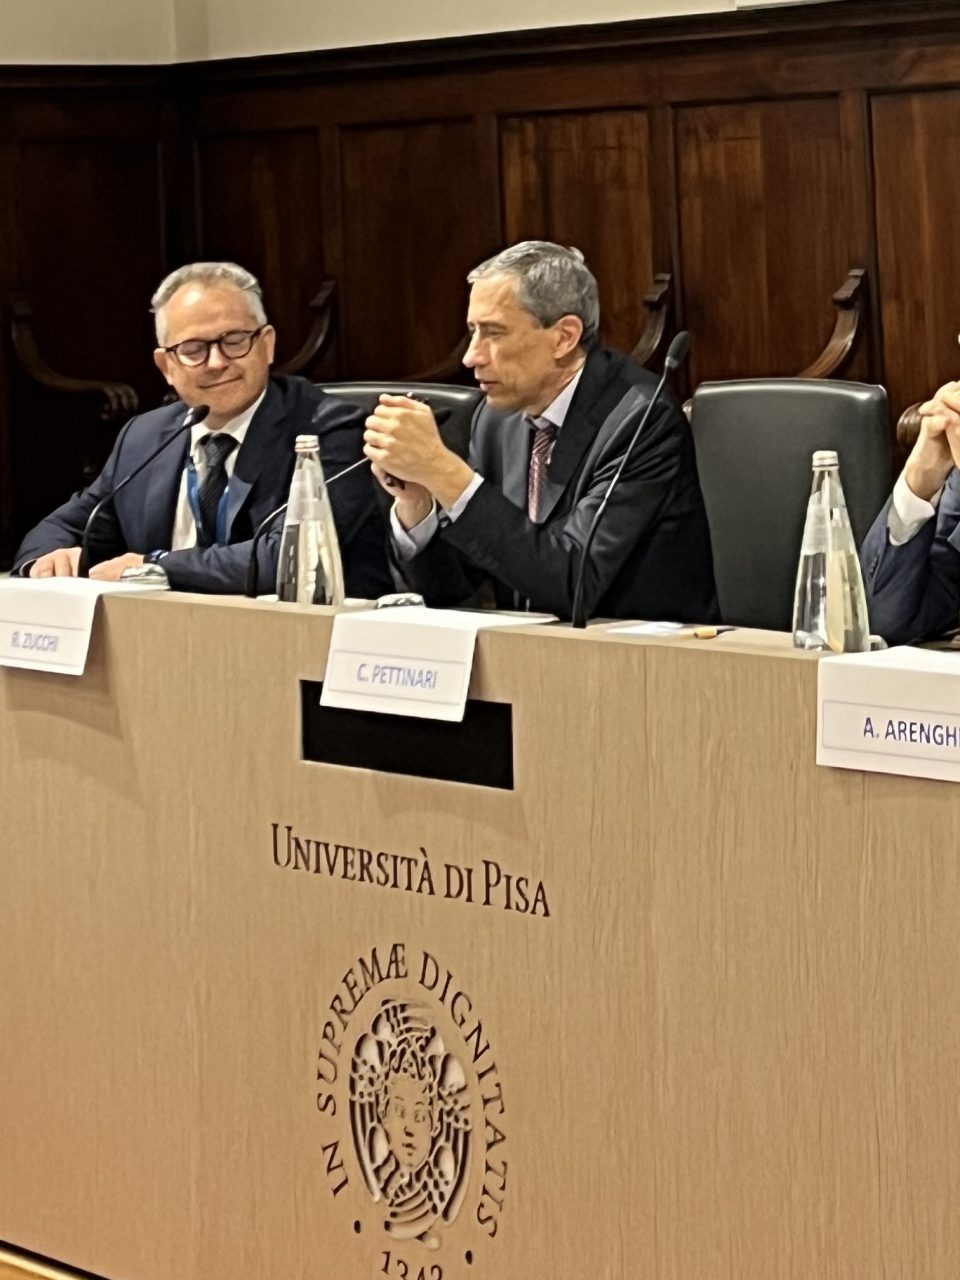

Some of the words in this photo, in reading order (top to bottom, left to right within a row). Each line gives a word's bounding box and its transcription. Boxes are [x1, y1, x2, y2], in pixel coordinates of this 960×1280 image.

[357, 663, 369, 682] C.
[371, 664, 438, 689] PETTINARI
[863, 717, 880, 739] A.
[418, 951, 509, 1238] DIGNITATIS
